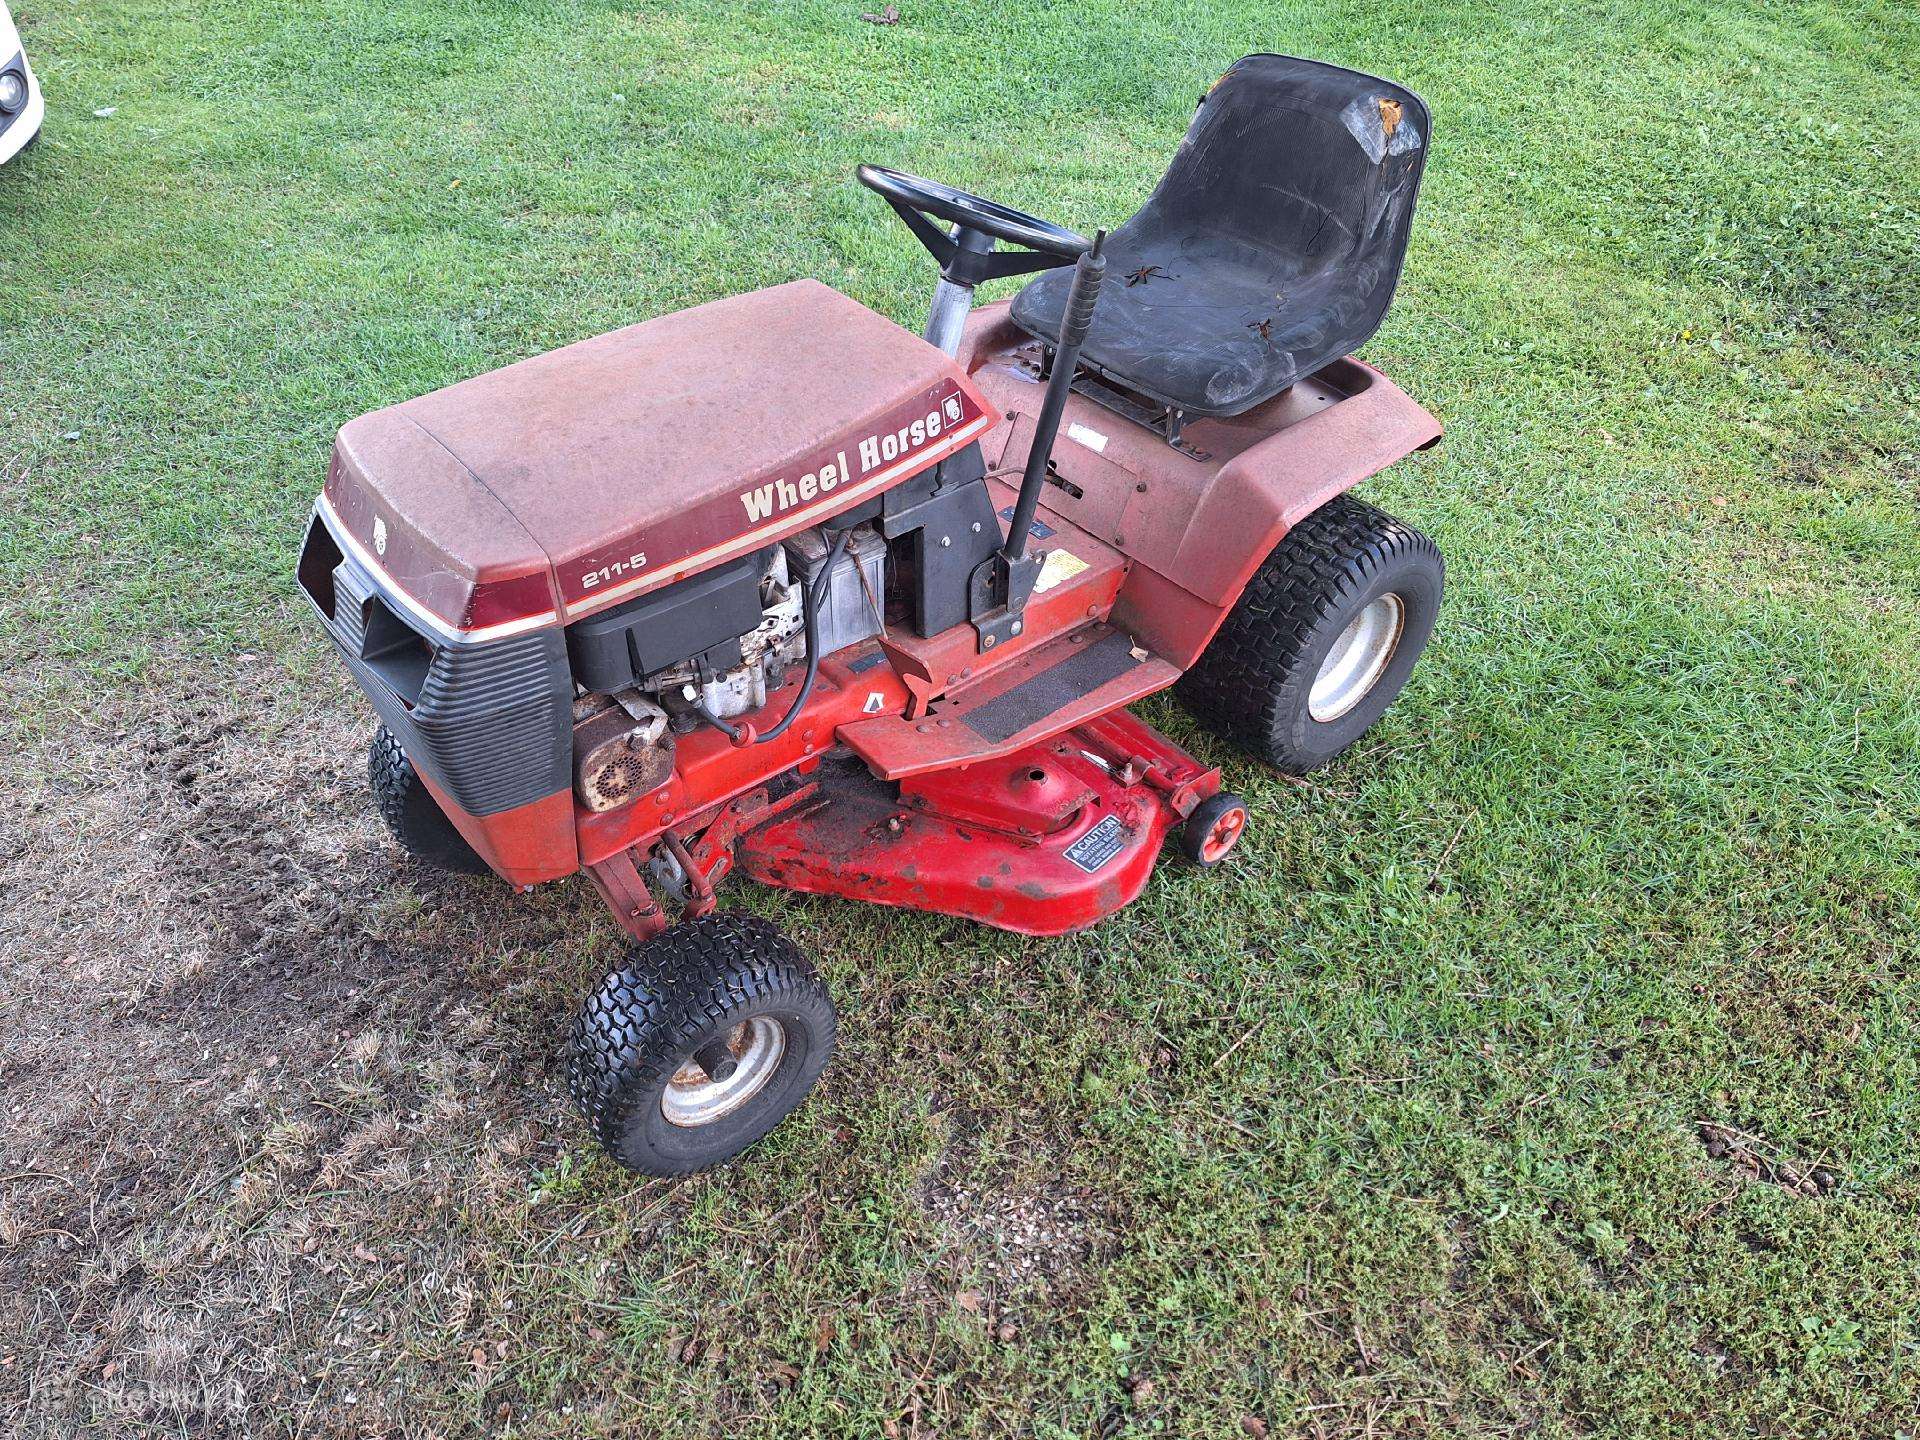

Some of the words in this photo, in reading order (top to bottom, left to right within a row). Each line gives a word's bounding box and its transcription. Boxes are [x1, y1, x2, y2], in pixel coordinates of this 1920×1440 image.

[740, 451, 850, 523] Wheel
[858, 410, 941, 472] Horse
[581, 552, 647, 589] 211-5
[1078, 818, 1117, 850] CAUTION
